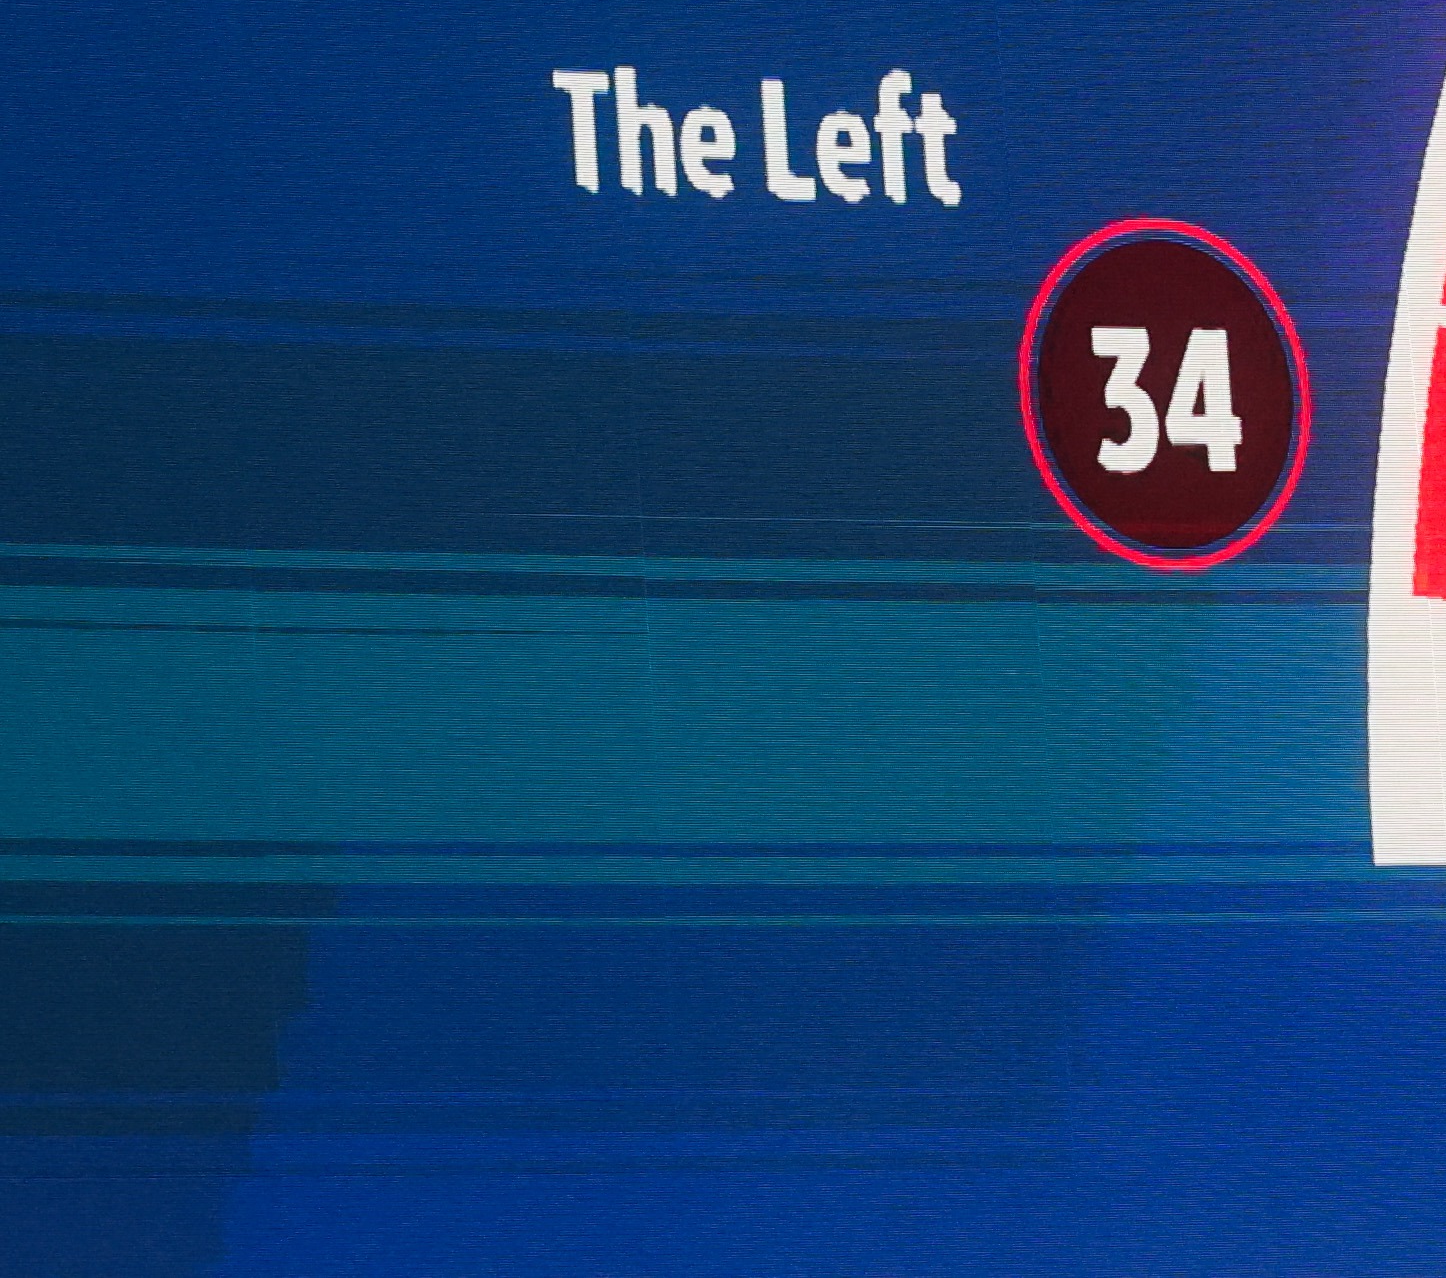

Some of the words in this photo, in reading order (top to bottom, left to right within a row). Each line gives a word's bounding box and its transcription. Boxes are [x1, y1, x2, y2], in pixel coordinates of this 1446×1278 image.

[553, 67, 734, 197] The
[762, 70, 960, 205] Left
[1092, 328, 1241, 472] 34
